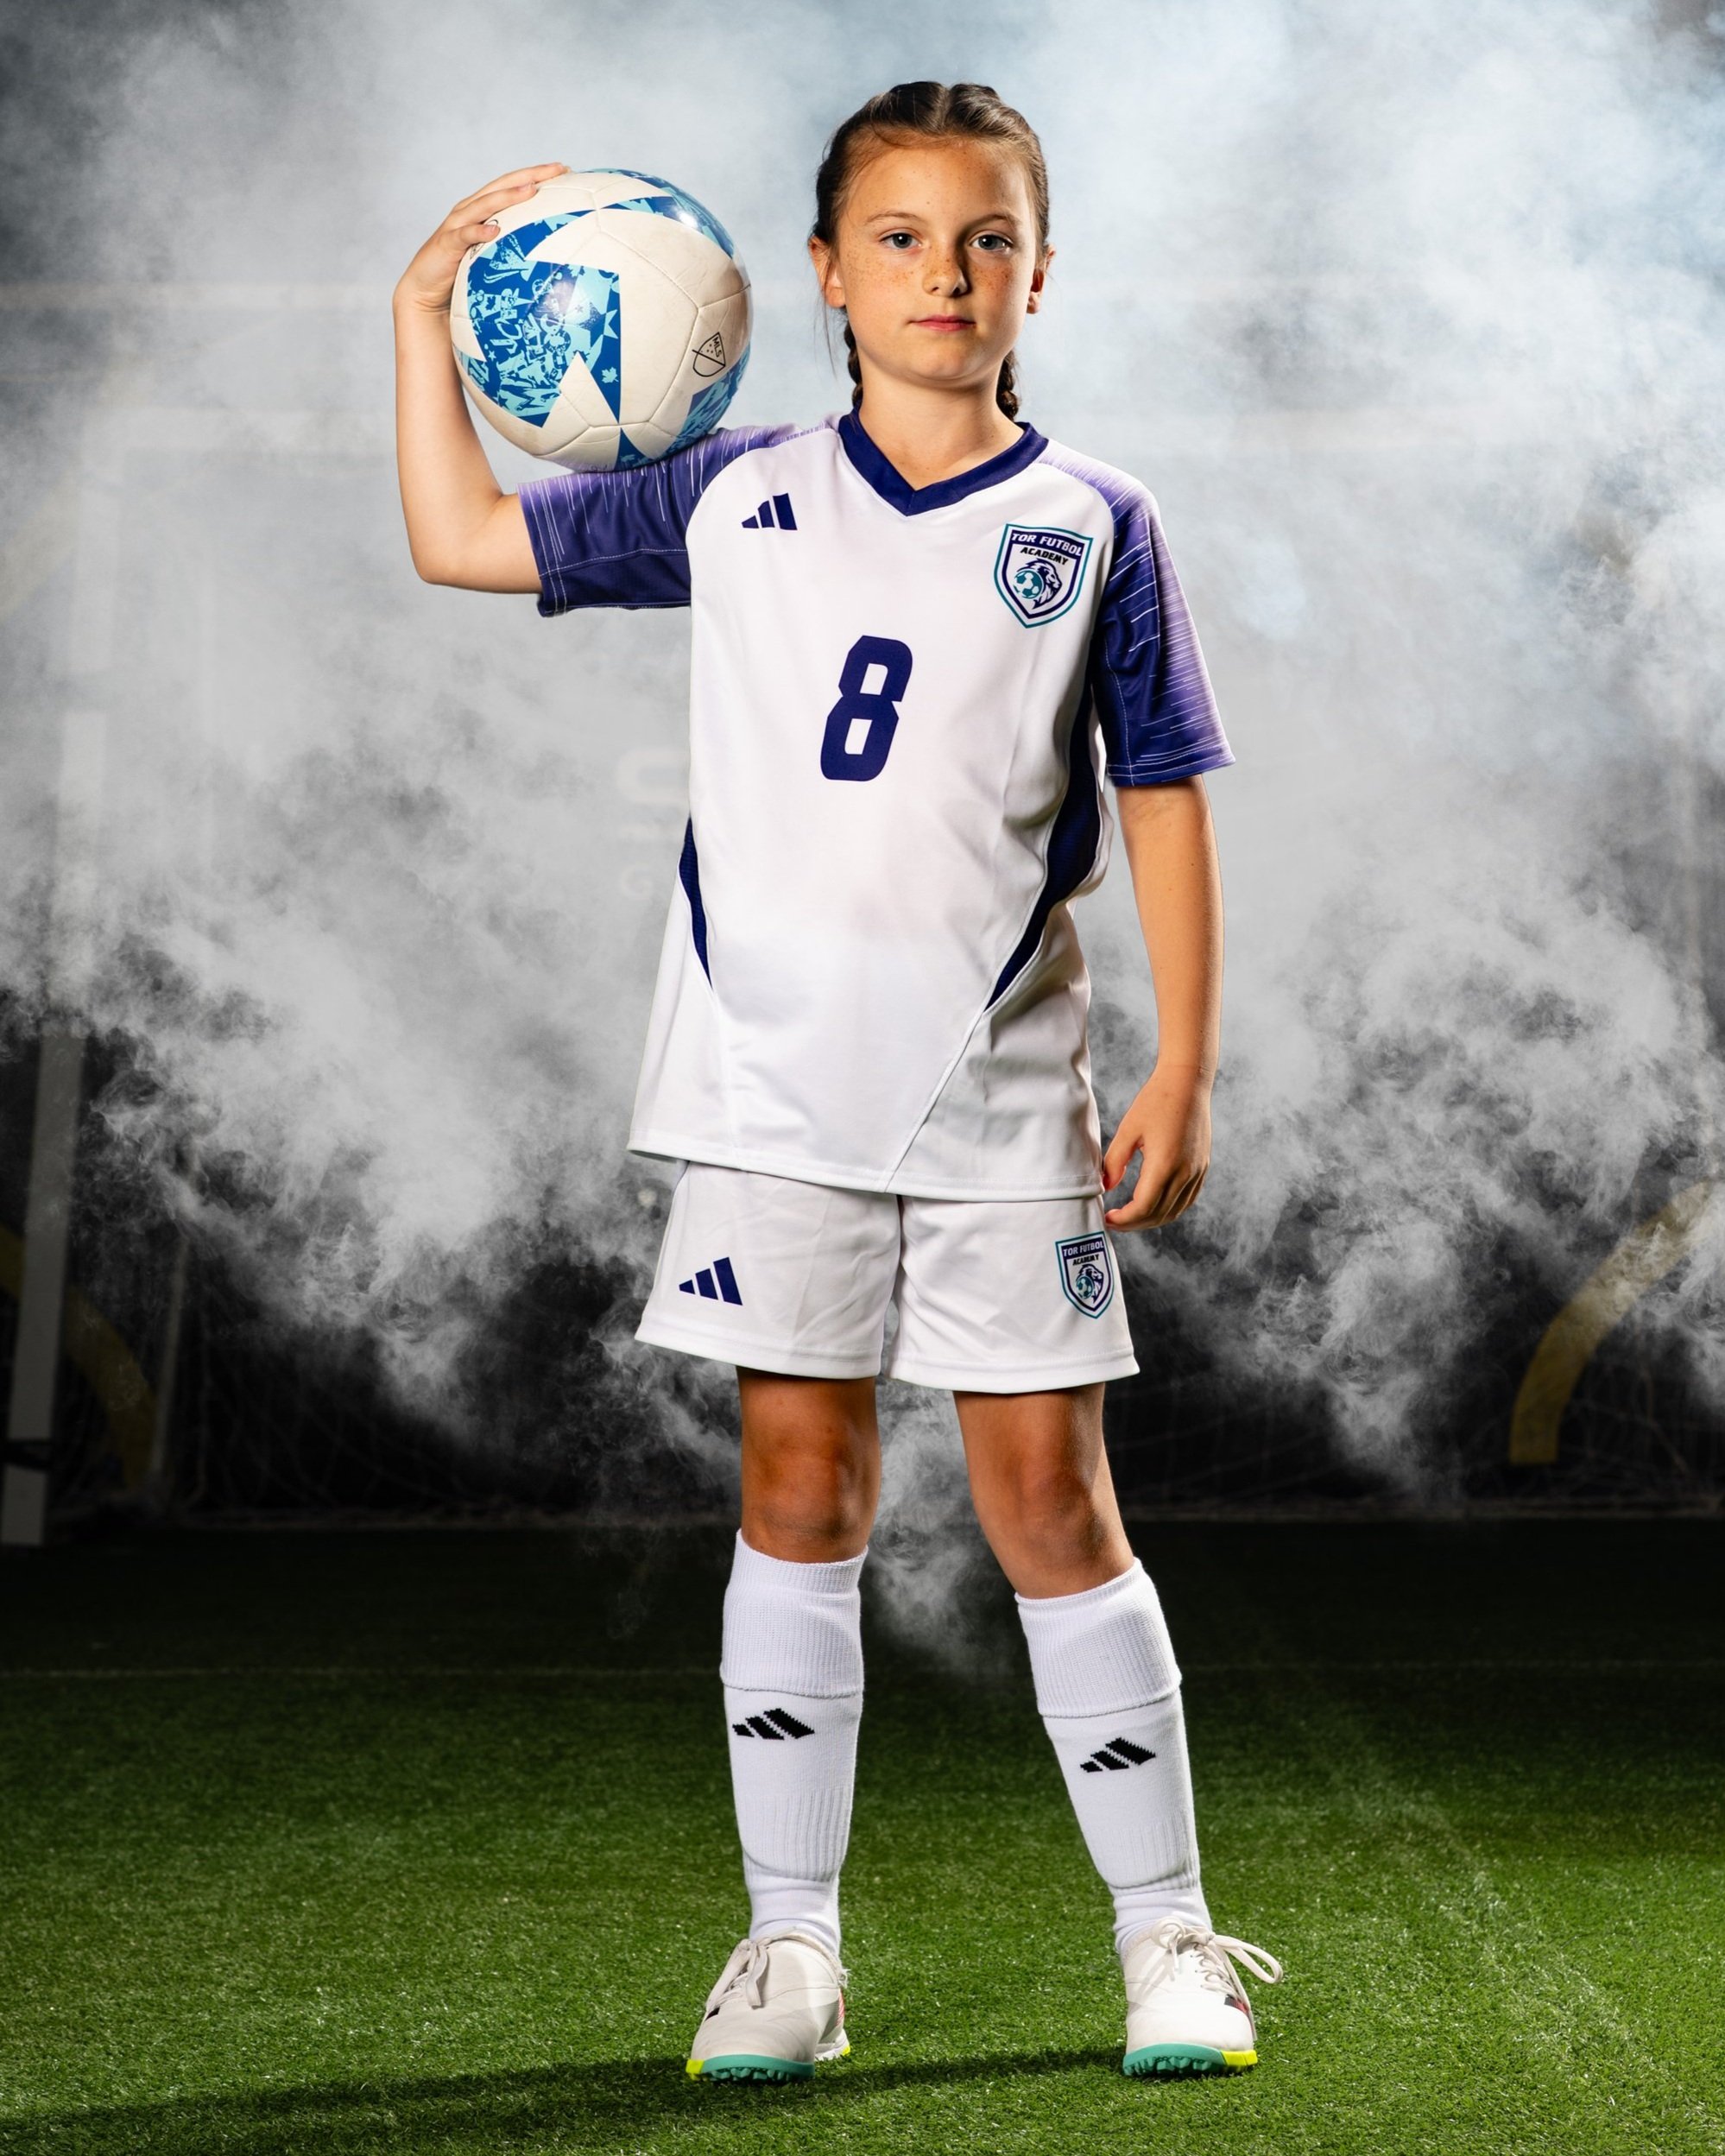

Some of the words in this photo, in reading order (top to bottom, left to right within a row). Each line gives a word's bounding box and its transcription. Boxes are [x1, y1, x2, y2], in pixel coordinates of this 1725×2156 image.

[712, 336, 722, 357] MLS
[1011, 533, 1037, 542] TOR
[1039, 535, 1082, 556] FUTBOL
[1020, 547, 1068, 566] ACADEMY
[820, 635, 913, 781] 8
[1063, 1247, 1078, 1257] TOR
[1079, 1241, 1104, 1253] FUTBOL
[1072, 1254, 1099, 1266] ACADEMY
